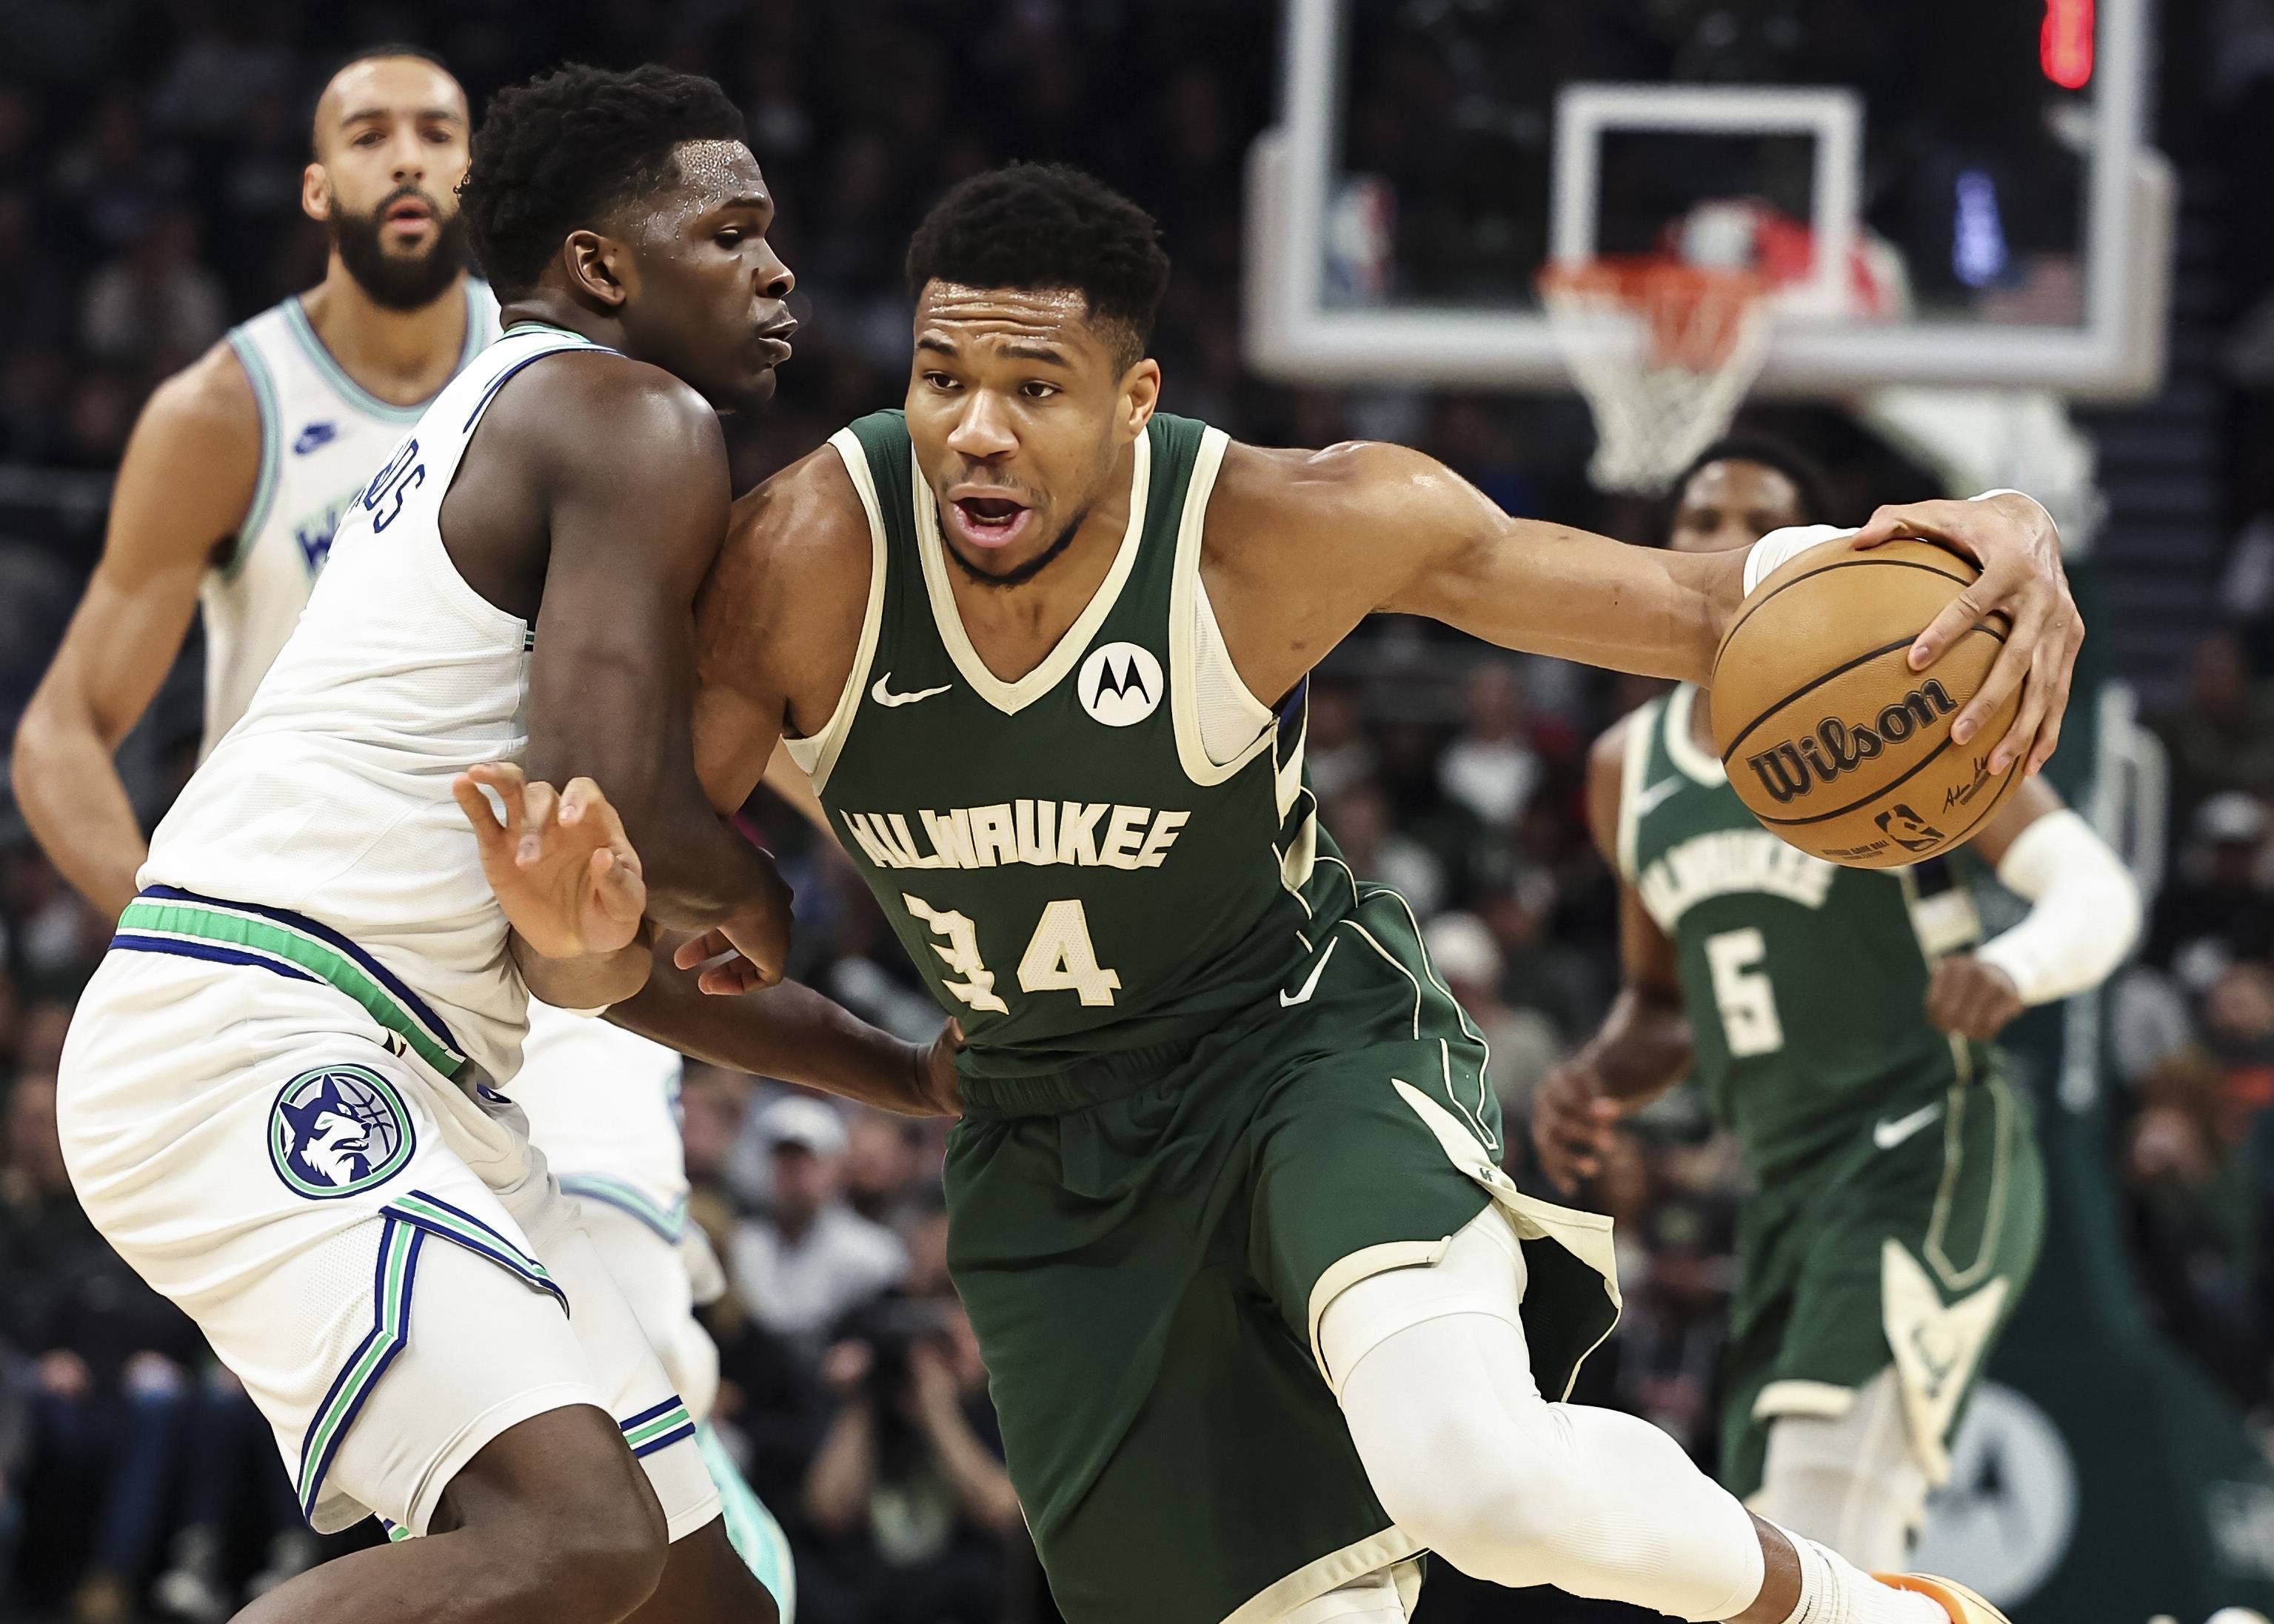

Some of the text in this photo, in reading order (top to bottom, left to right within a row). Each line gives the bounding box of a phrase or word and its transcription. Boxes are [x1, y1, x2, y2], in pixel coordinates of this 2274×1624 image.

[351, 437, 426, 534] DS
[1746, 678, 1959, 803] Wilson
[840, 799, 1192, 869] MILWAUKEE
[902, 892, 1122, 1015] 34
[1705, 926, 1785, 1059] 5
